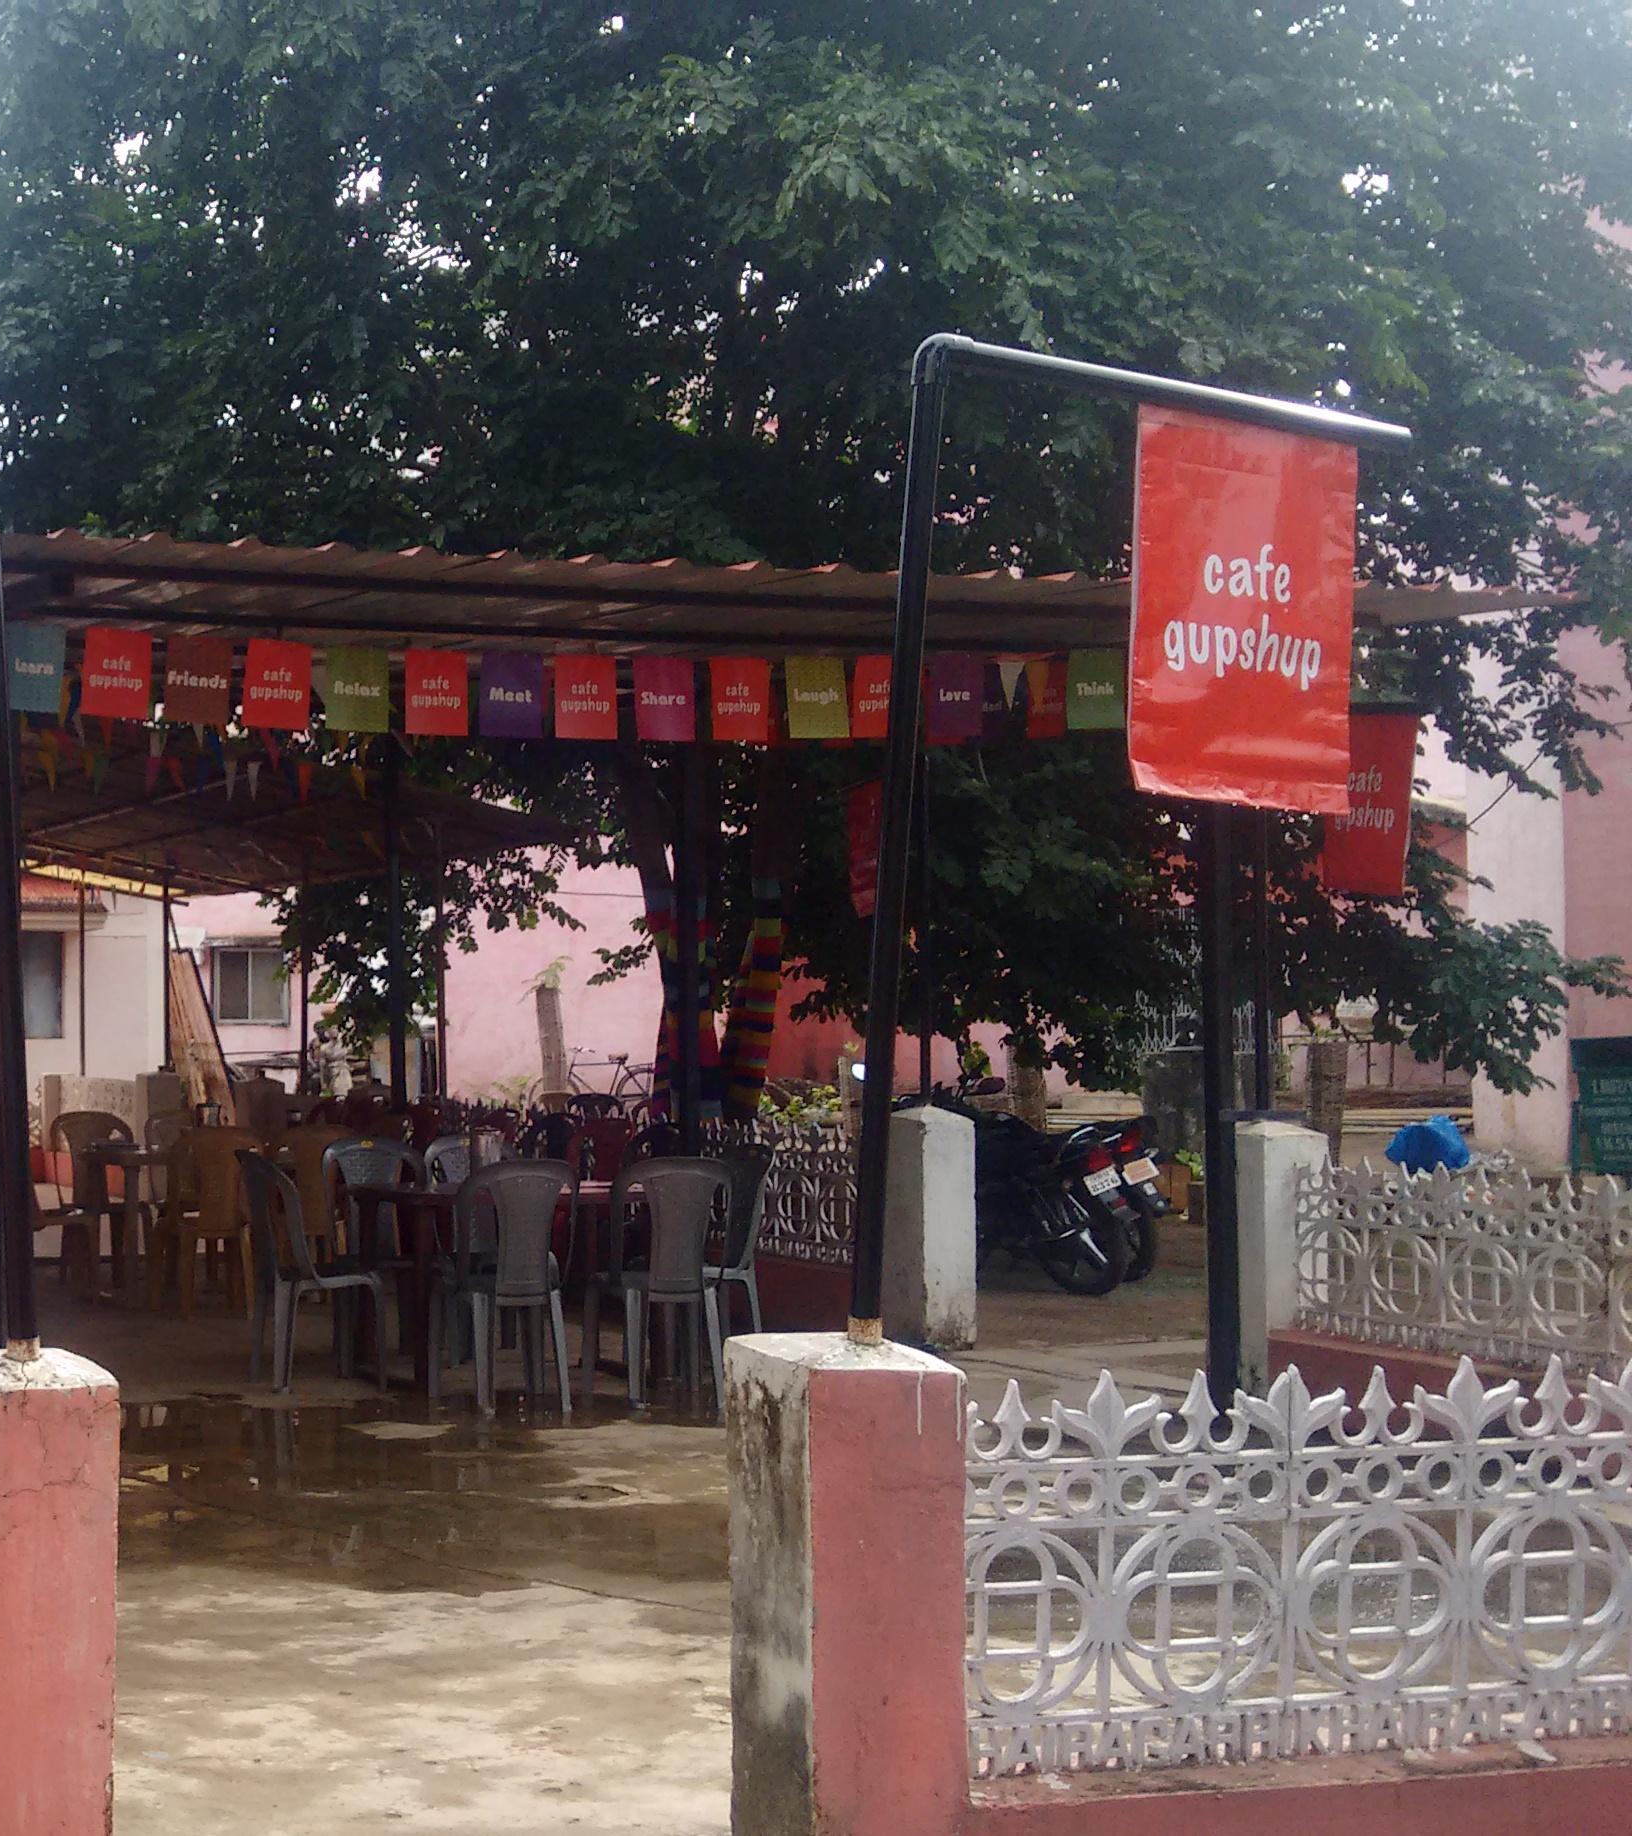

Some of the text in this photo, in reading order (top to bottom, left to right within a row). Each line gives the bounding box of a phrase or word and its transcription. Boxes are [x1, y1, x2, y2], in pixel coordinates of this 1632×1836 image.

[1204, 544, 1291, 602] cafe
[1164, 614, 1321, 691] gupshup
[15, 658, 54, 675] Learn
[102, 656, 132, 672] cafe
[89, 672, 143, 691] gupshup
[168, 671, 227, 689] Friends
[263, 667, 292, 682] cafe
[422, 675, 450, 691] cafe
[250, 685, 303, 703] gupshup
[334, 680, 380, 697] Relax
[489, 686, 532, 703] Meet
[571, 681, 598, 695] cafe
[725, 682, 749, 697] cafe
[793, 687, 838, 705] Laugh
[939, 688, 970, 702] Love
[1076, 682, 1115, 697] Think
[411, 692, 461, 709] gupshup
[561, 697, 610, 714] gupshup
[641, 691, 686, 706] Share
[717, 699, 761, 716] gupshup
[1347, 764, 1383, 792] cafe
